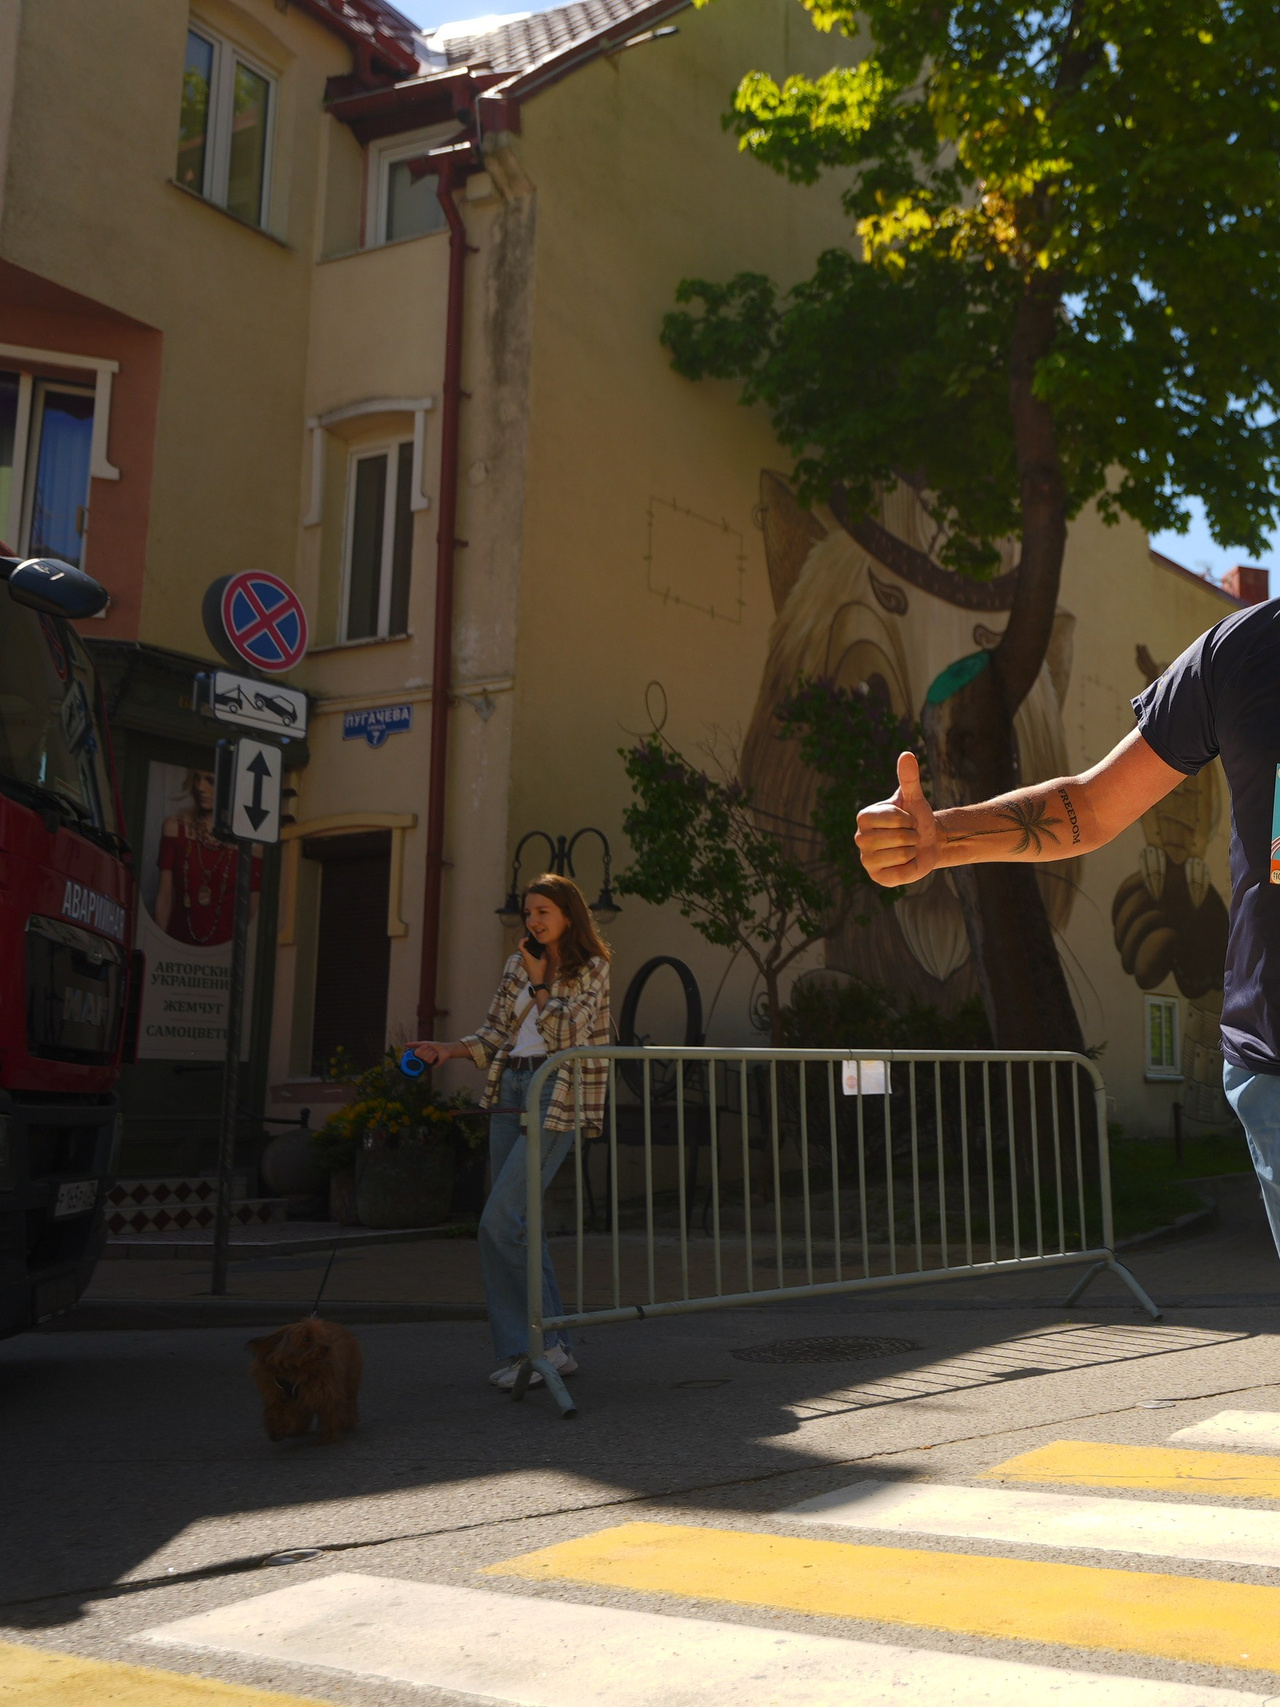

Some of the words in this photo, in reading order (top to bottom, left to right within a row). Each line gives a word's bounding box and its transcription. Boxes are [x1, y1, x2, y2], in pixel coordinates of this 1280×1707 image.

[345, 707, 410, 728] ПУГАЧЕВА
[372, 732, 380, 745] 7
[1058, 788, 1081, 845] FREEDOM
[155, 960, 232, 979] АВТОРСКИ
[151, 973, 231, 990] УКРАШЕНИ
[163, 999, 224, 1015] ЖЕМЧУГ
